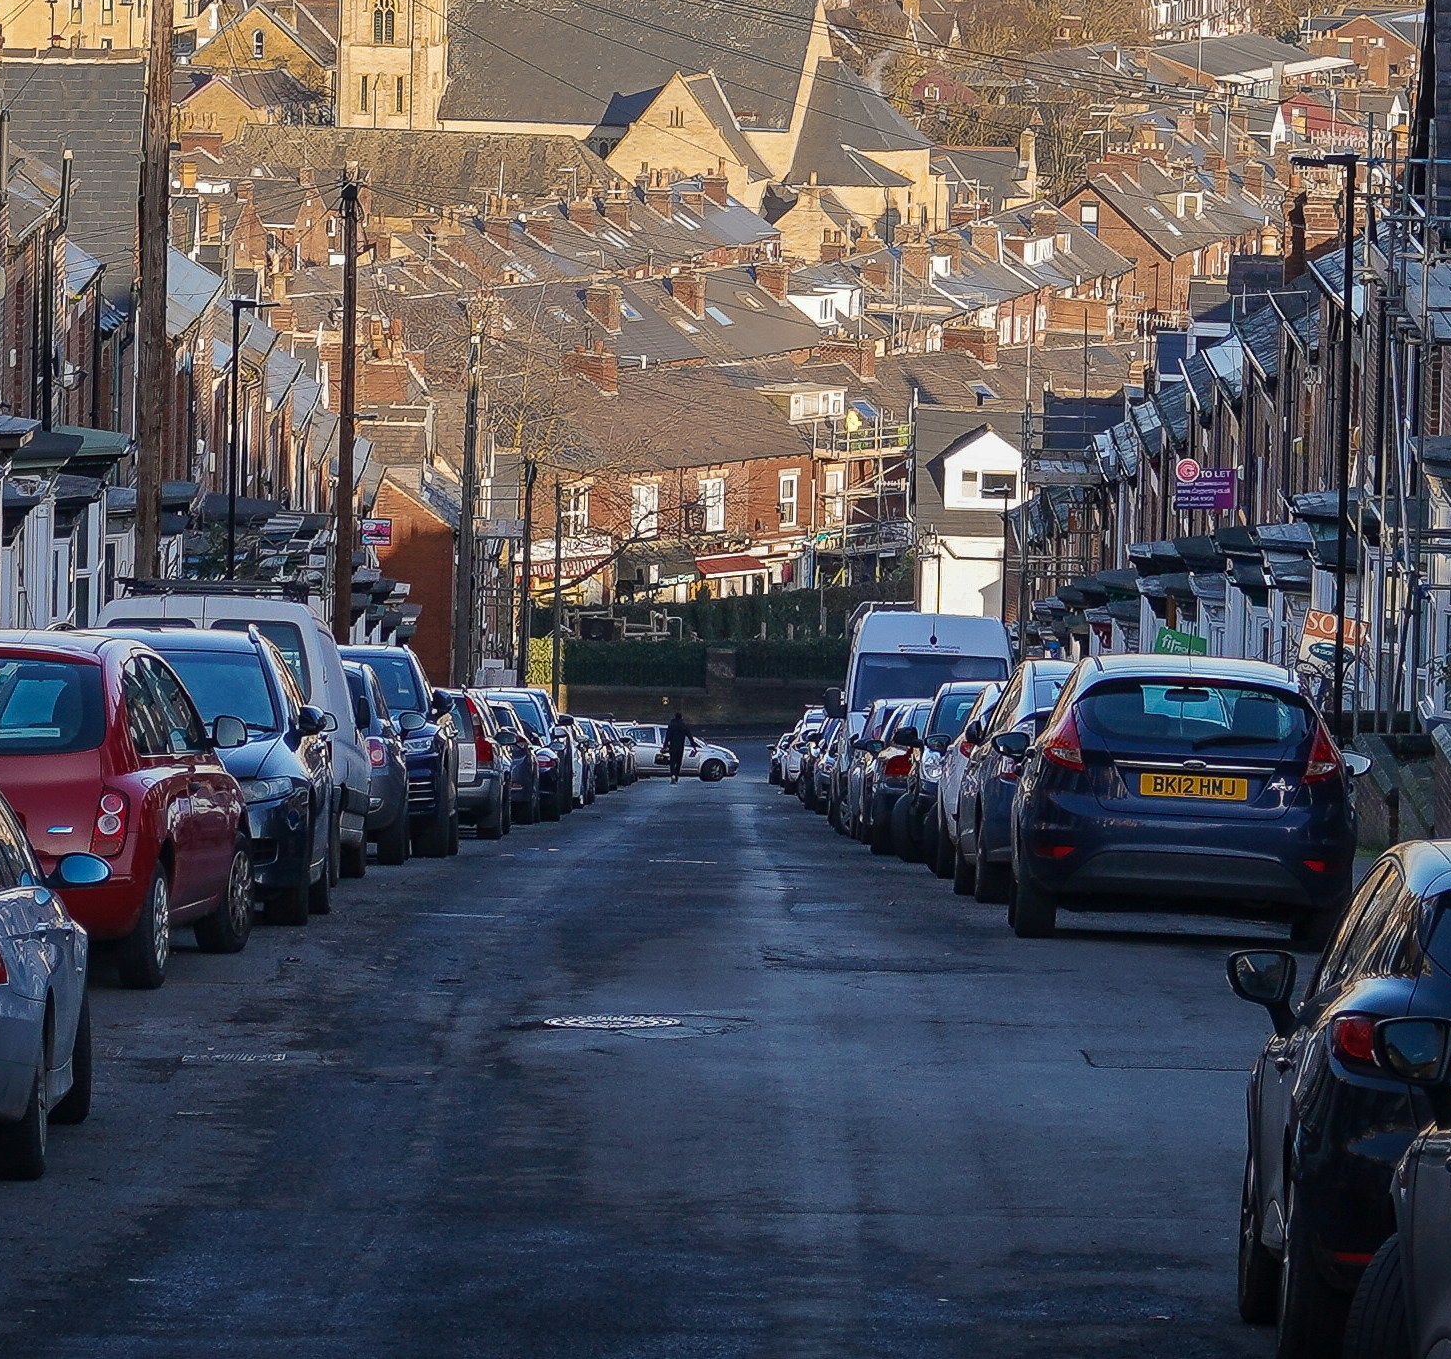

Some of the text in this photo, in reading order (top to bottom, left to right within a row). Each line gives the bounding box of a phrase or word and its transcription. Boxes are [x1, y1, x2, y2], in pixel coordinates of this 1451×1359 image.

[1200, 470, 1231, 478] TO LET
[1153, 776, 1236, 796] BK12 HMJ
